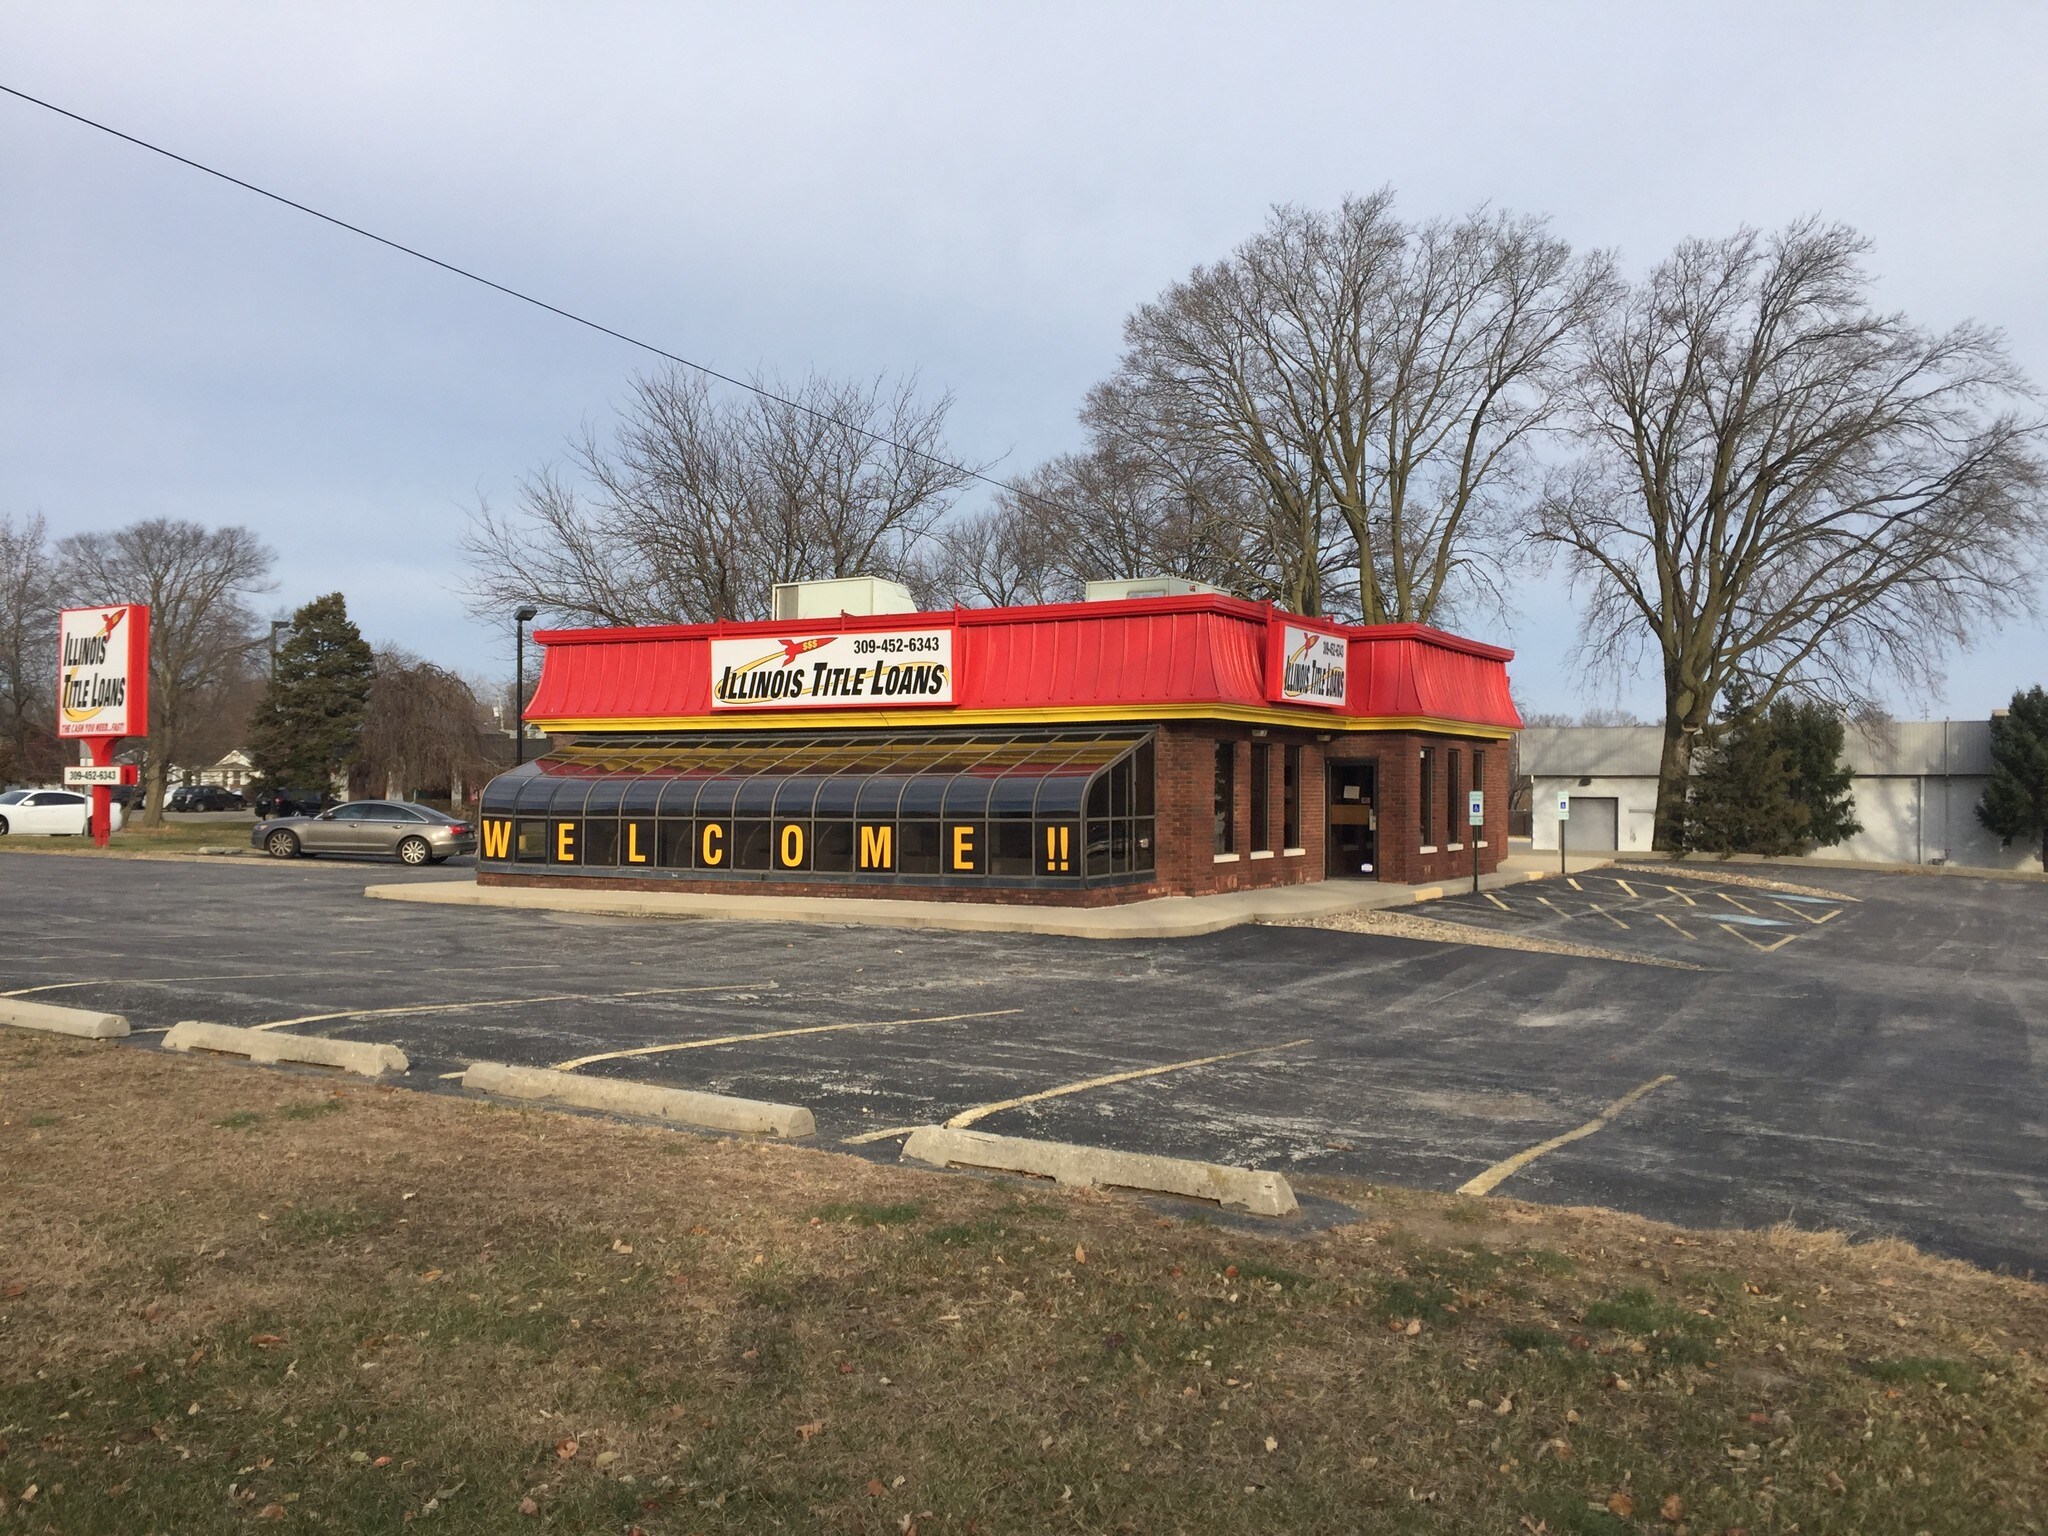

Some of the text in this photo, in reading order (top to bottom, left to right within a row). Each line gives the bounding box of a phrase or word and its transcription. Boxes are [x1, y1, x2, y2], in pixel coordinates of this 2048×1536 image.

[63, 632, 107, 667] ILLINOIS
[802, 639, 818, 651] $$$
[853, 637, 940, 655] 309-452-6343
[62, 673, 126, 709] TITLE LOANS
[719, 660, 945, 700] ILLINOIS TITLE LOANS
[69, 770, 116, 781] 309-452-6343
